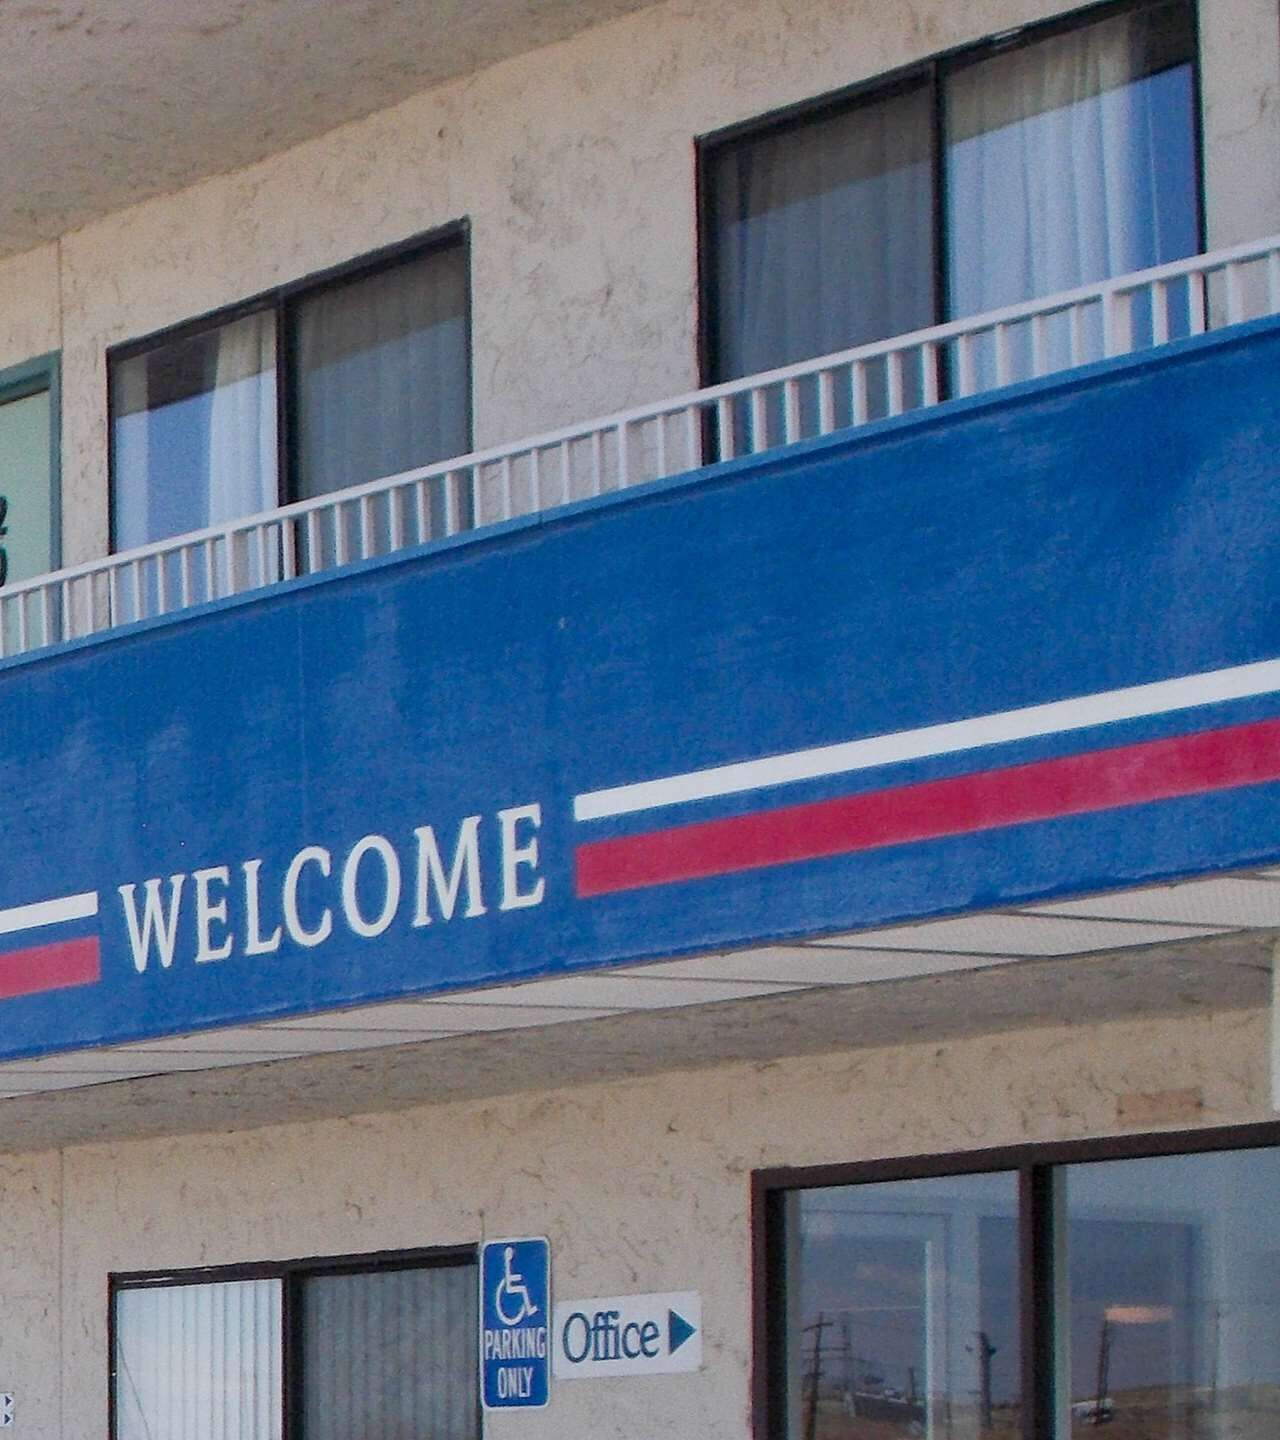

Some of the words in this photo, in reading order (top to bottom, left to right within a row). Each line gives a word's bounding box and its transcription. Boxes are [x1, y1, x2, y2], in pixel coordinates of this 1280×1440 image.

[118, 803, 544, 972] WELCOME
[484, 1326, 546, 1361] PARKING
[562, 1310, 660, 1364] Office
[497, 1367, 533, 1399] ONLY
